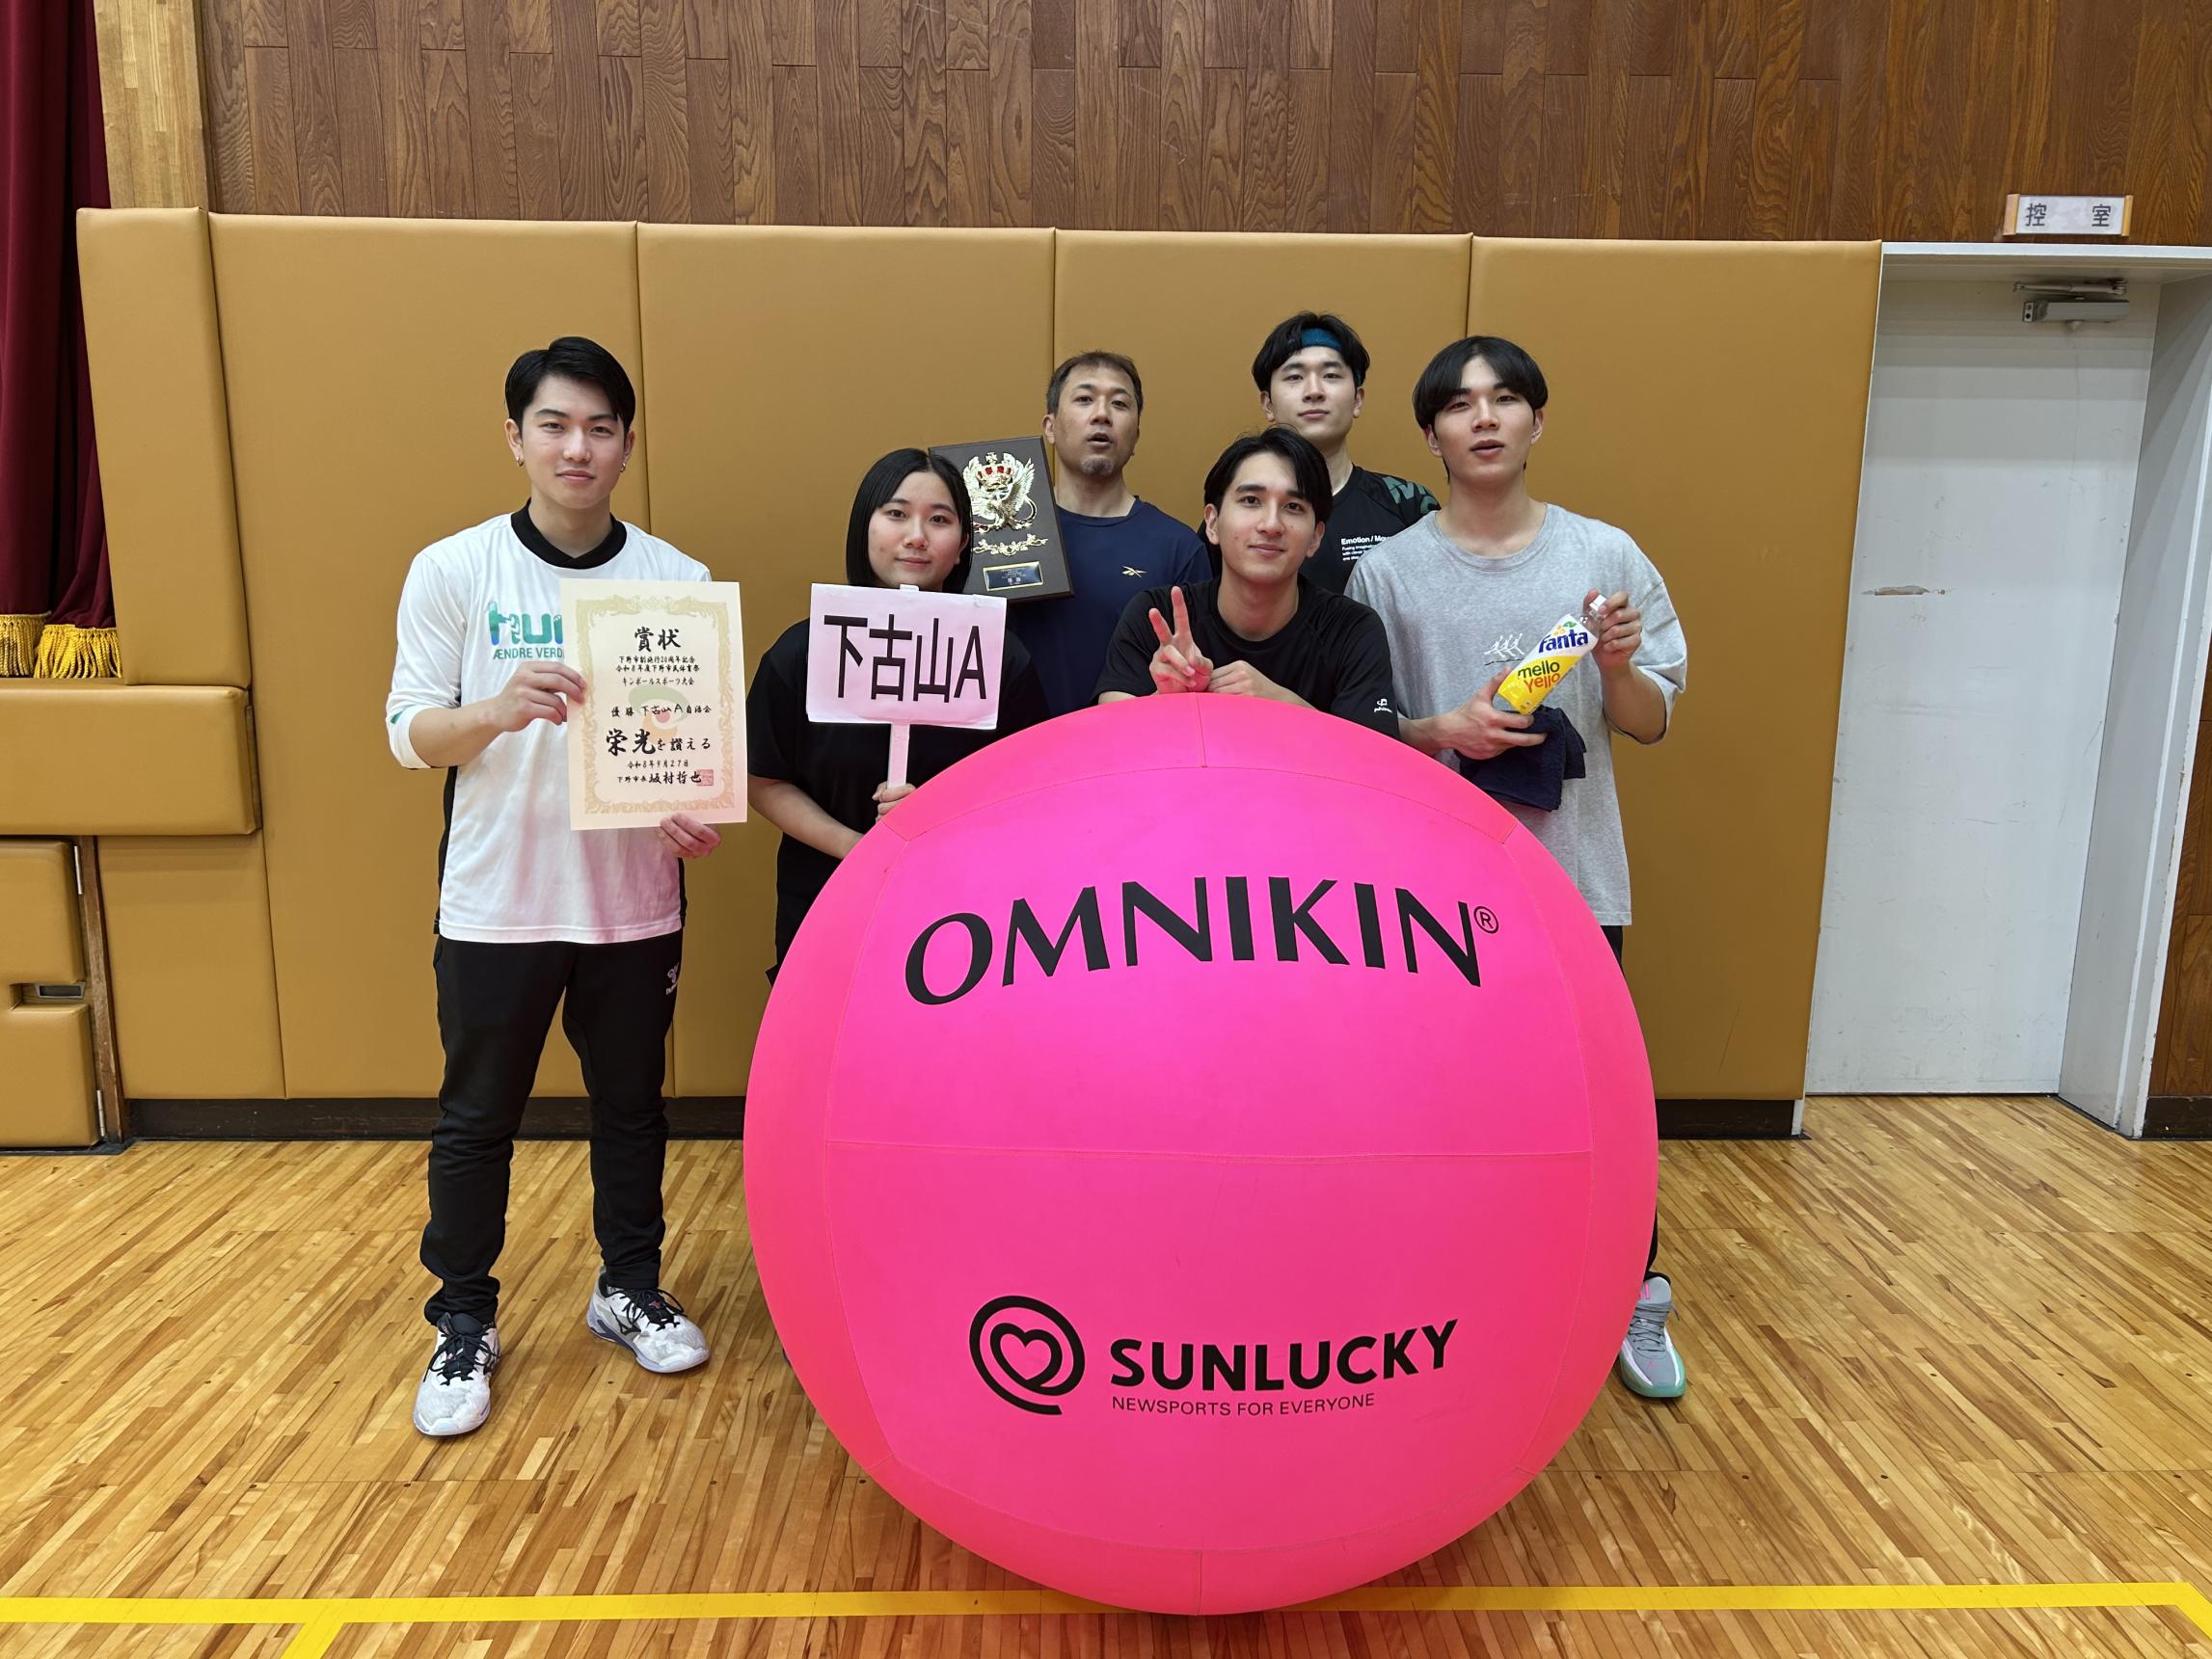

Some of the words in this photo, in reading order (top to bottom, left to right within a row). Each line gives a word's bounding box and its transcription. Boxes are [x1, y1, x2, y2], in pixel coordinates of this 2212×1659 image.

[2025, 202, 2112, 227] 控室
[634, 626, 682, 653] 賞状
[1538, 629, 1589, 654] Fanta
[493, 647, 533, 660] ÆNDRE
[536, 647, 565, 658] VERD
[823, 613, 987, 704] 下古山A
[622, 677, 695, 686] キンボールスポーツ大会
[1518, 659, 1560, 680] mello
[1110, 1318, 1459, 1391] SUNLUCKY
[1112, 1395, 1231, 1416] NEWSPORTS
[1237, 1401, 1274, 1416] FOR
[1280, 1393, 1375, 1415] EVERYONE
